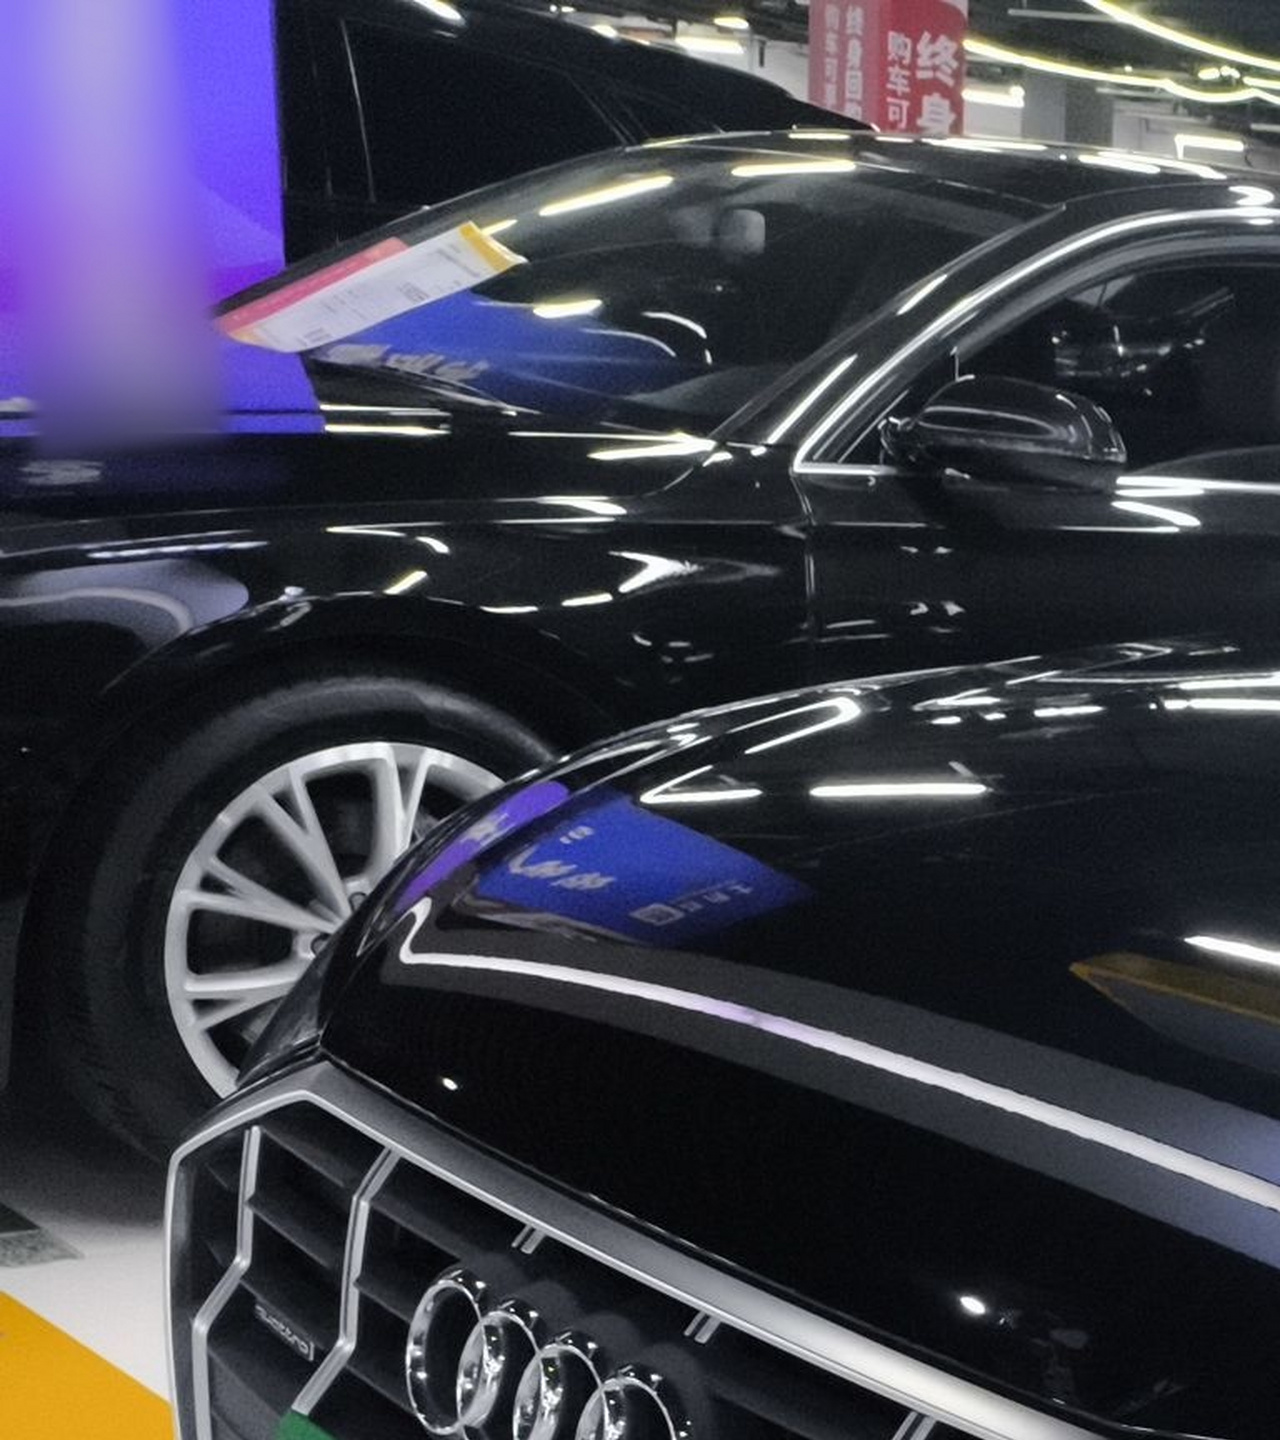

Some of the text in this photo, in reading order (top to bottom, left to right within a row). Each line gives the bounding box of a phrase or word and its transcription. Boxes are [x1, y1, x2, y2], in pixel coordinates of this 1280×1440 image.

[886, 31, 911, 129] 购车可
[916, 31, 958, 134] 终身
